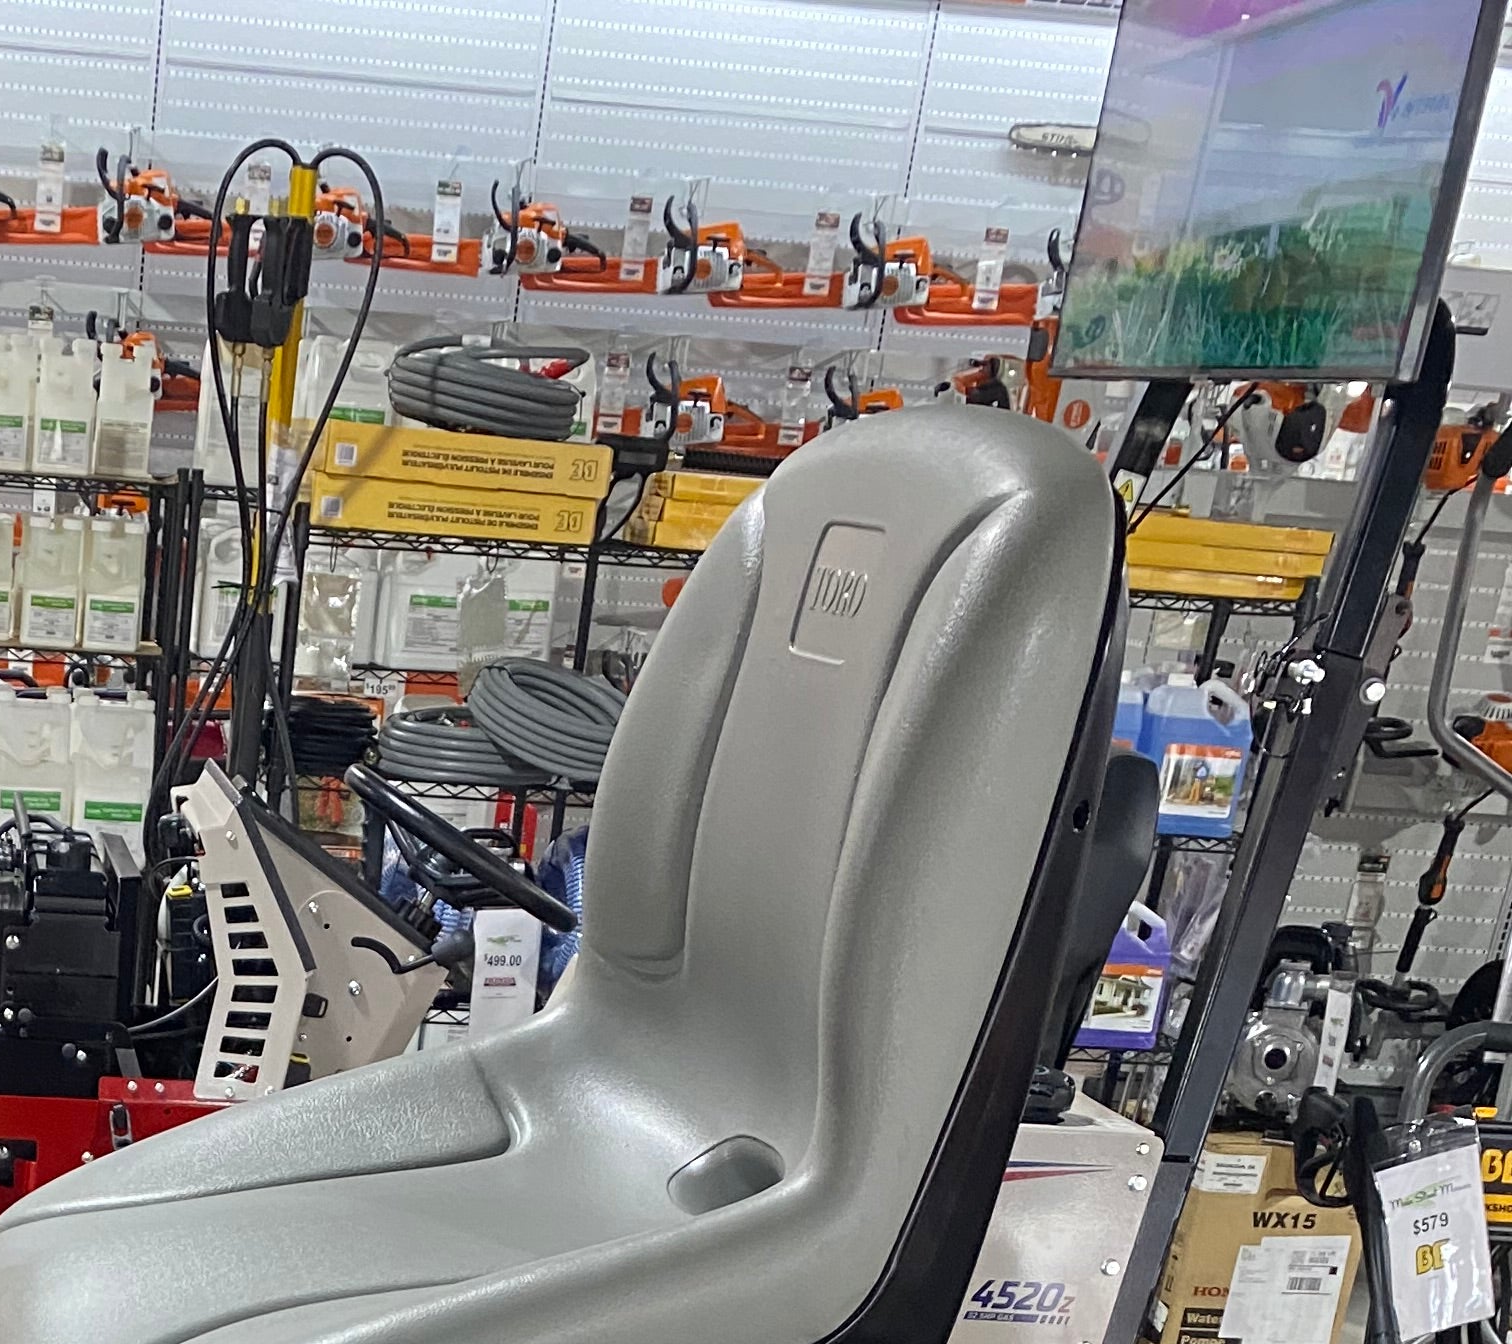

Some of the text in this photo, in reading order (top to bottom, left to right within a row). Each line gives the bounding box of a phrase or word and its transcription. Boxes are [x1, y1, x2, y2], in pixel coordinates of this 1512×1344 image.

[809, 567, 868, 618] TORO
[484, 953, 522, 967] $499.00
[1252, 1211, 1317, 1230] WX15
[1413, 1212, 1449, 1236] $579
[1193, 1286, 1230, 1298] HON
